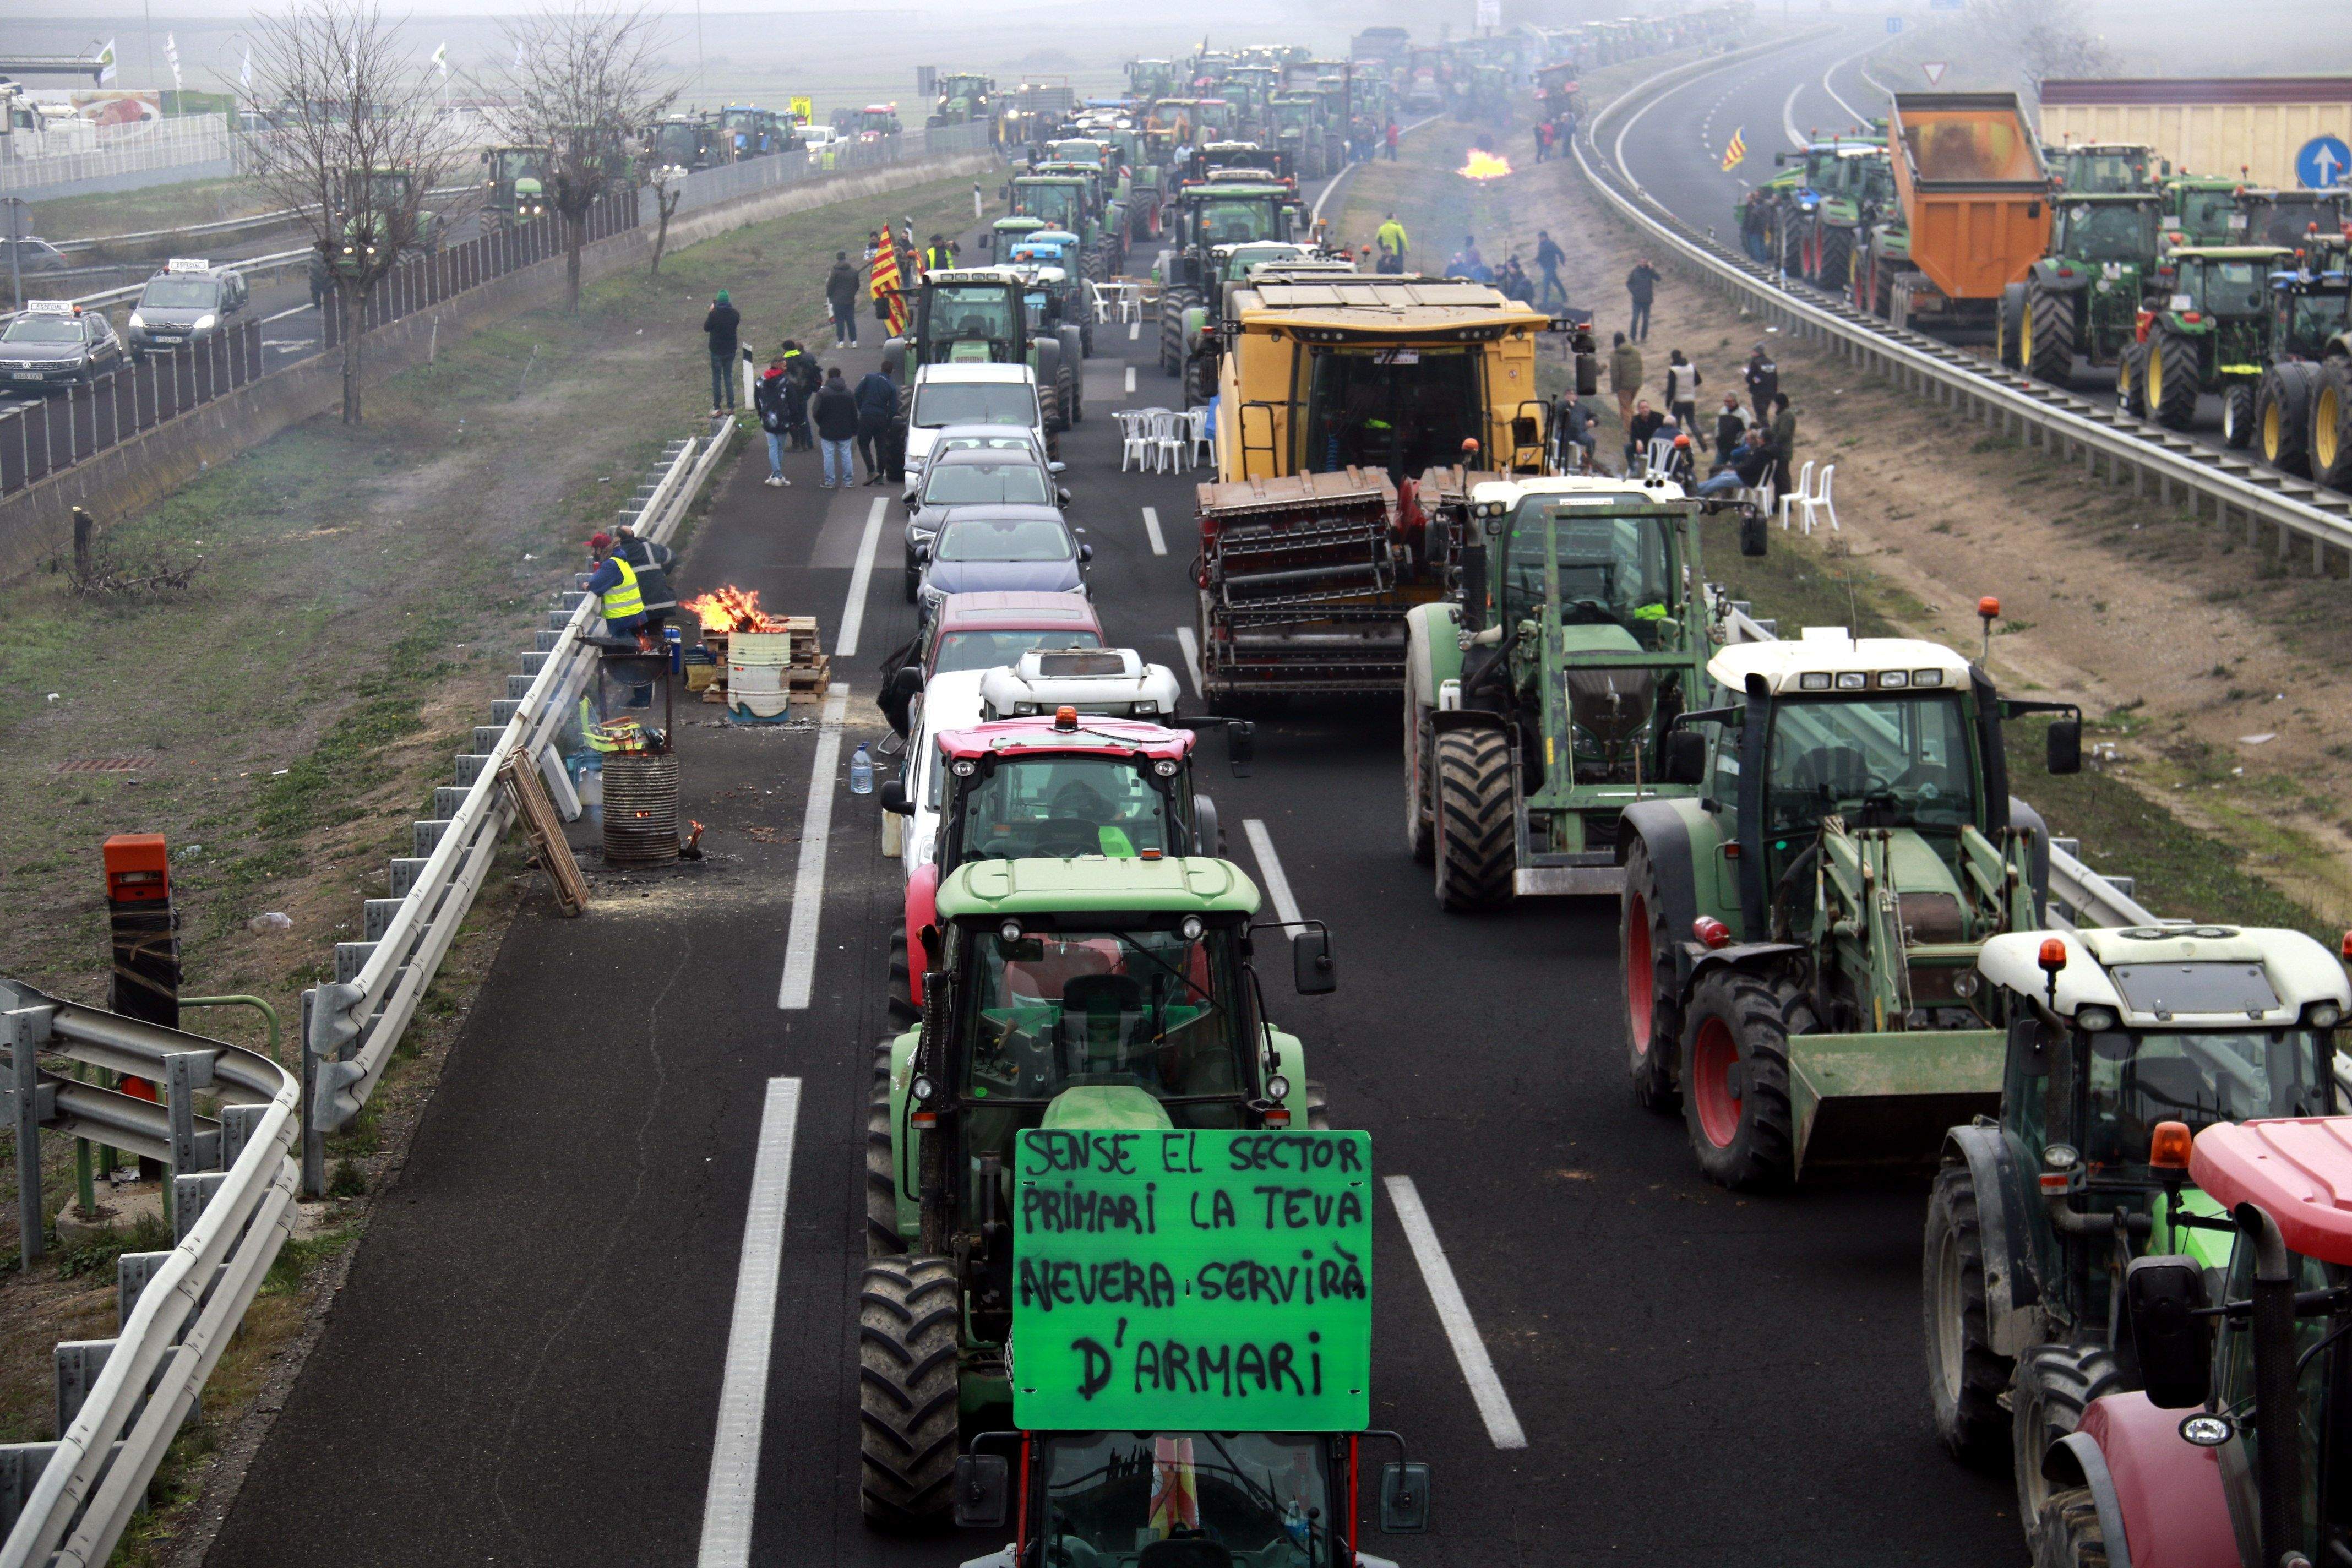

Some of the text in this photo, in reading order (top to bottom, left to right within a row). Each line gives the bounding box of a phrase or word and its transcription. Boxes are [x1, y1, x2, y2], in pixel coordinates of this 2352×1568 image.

[1025, 1130, 1363, 1175] SENSE EL SECTOR
[1191, 1189, 1236, 1229] LA
[1254, 1185, 1363, 1228] TEVA
[1019, 1258, 1175, 1313] NEVERA
